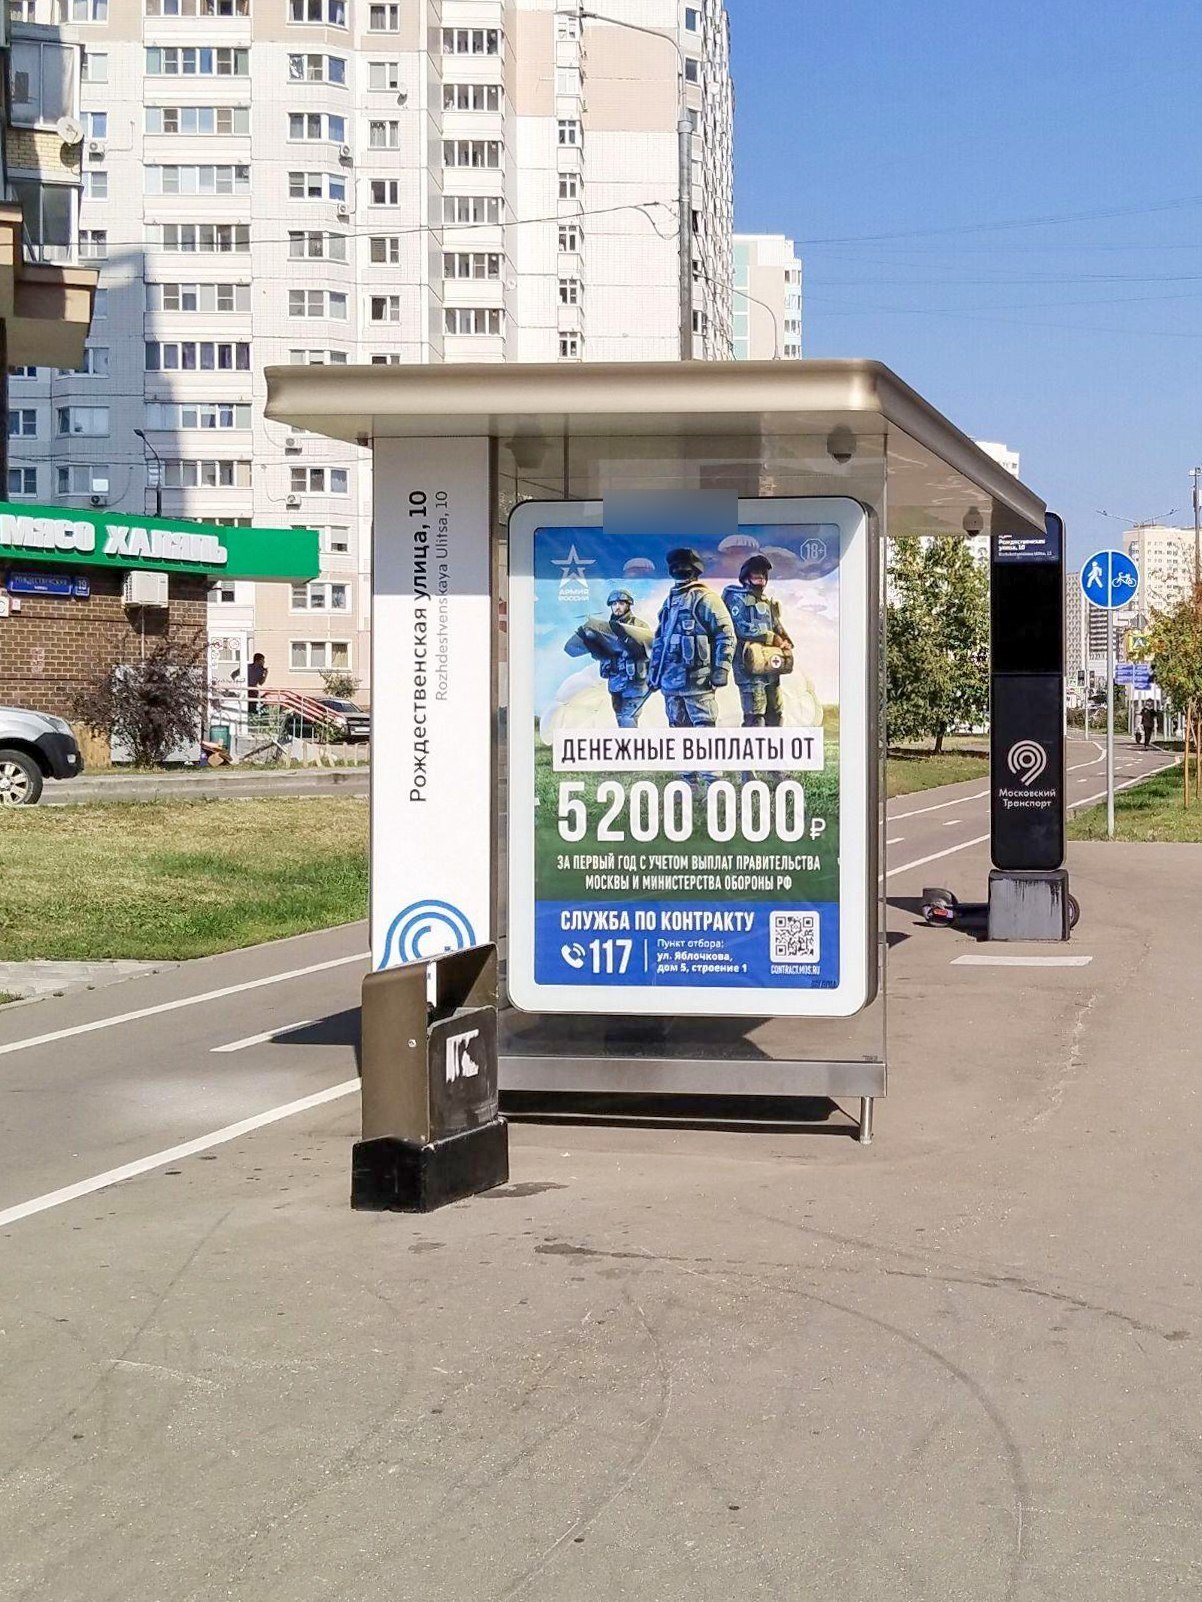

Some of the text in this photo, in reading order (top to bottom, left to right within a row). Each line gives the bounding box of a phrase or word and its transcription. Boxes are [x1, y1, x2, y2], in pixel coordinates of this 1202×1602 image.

[805, 543, 824, 560] 18+
[435, 491, 451, 701] Rozhdestvenskaya Ulitsa, 10
[409, 490, 431, 802] Рождественская улица, 10
[561, 737, 815, 763] ДЕНЕЖНЫЕ ВЫПЛАТЫ ОТ
[999, 788, 1056, 798] Московский
[558, 781, 587, 842] 5
[596, 780, 693, 842] 200
[707, 780, 805, 842] 000
[1002, 799, 1052, 809] Транспорт
[557, 852, 821, 871] ЗА ПЕРВЫЙ ГОД С УЧЕТОМ ВЫПЛАТ ПРАВИТЕЛЬСТВА
[585, 875, 792, 891] МОСКВЫ И МИНИСТЕРСТВА ОБОРОНЫ РФ
[561, 910, 755, 932] СЛУЖБА ПО КОНТРАКТУ
[657, 938, 724, 950] Пункт отбора:
[589, 938, 633, 974] 117
[657, 951, 733, 962] ул. Яблочкова,
[657, 963, 748, 974] дом 5, строение 1
